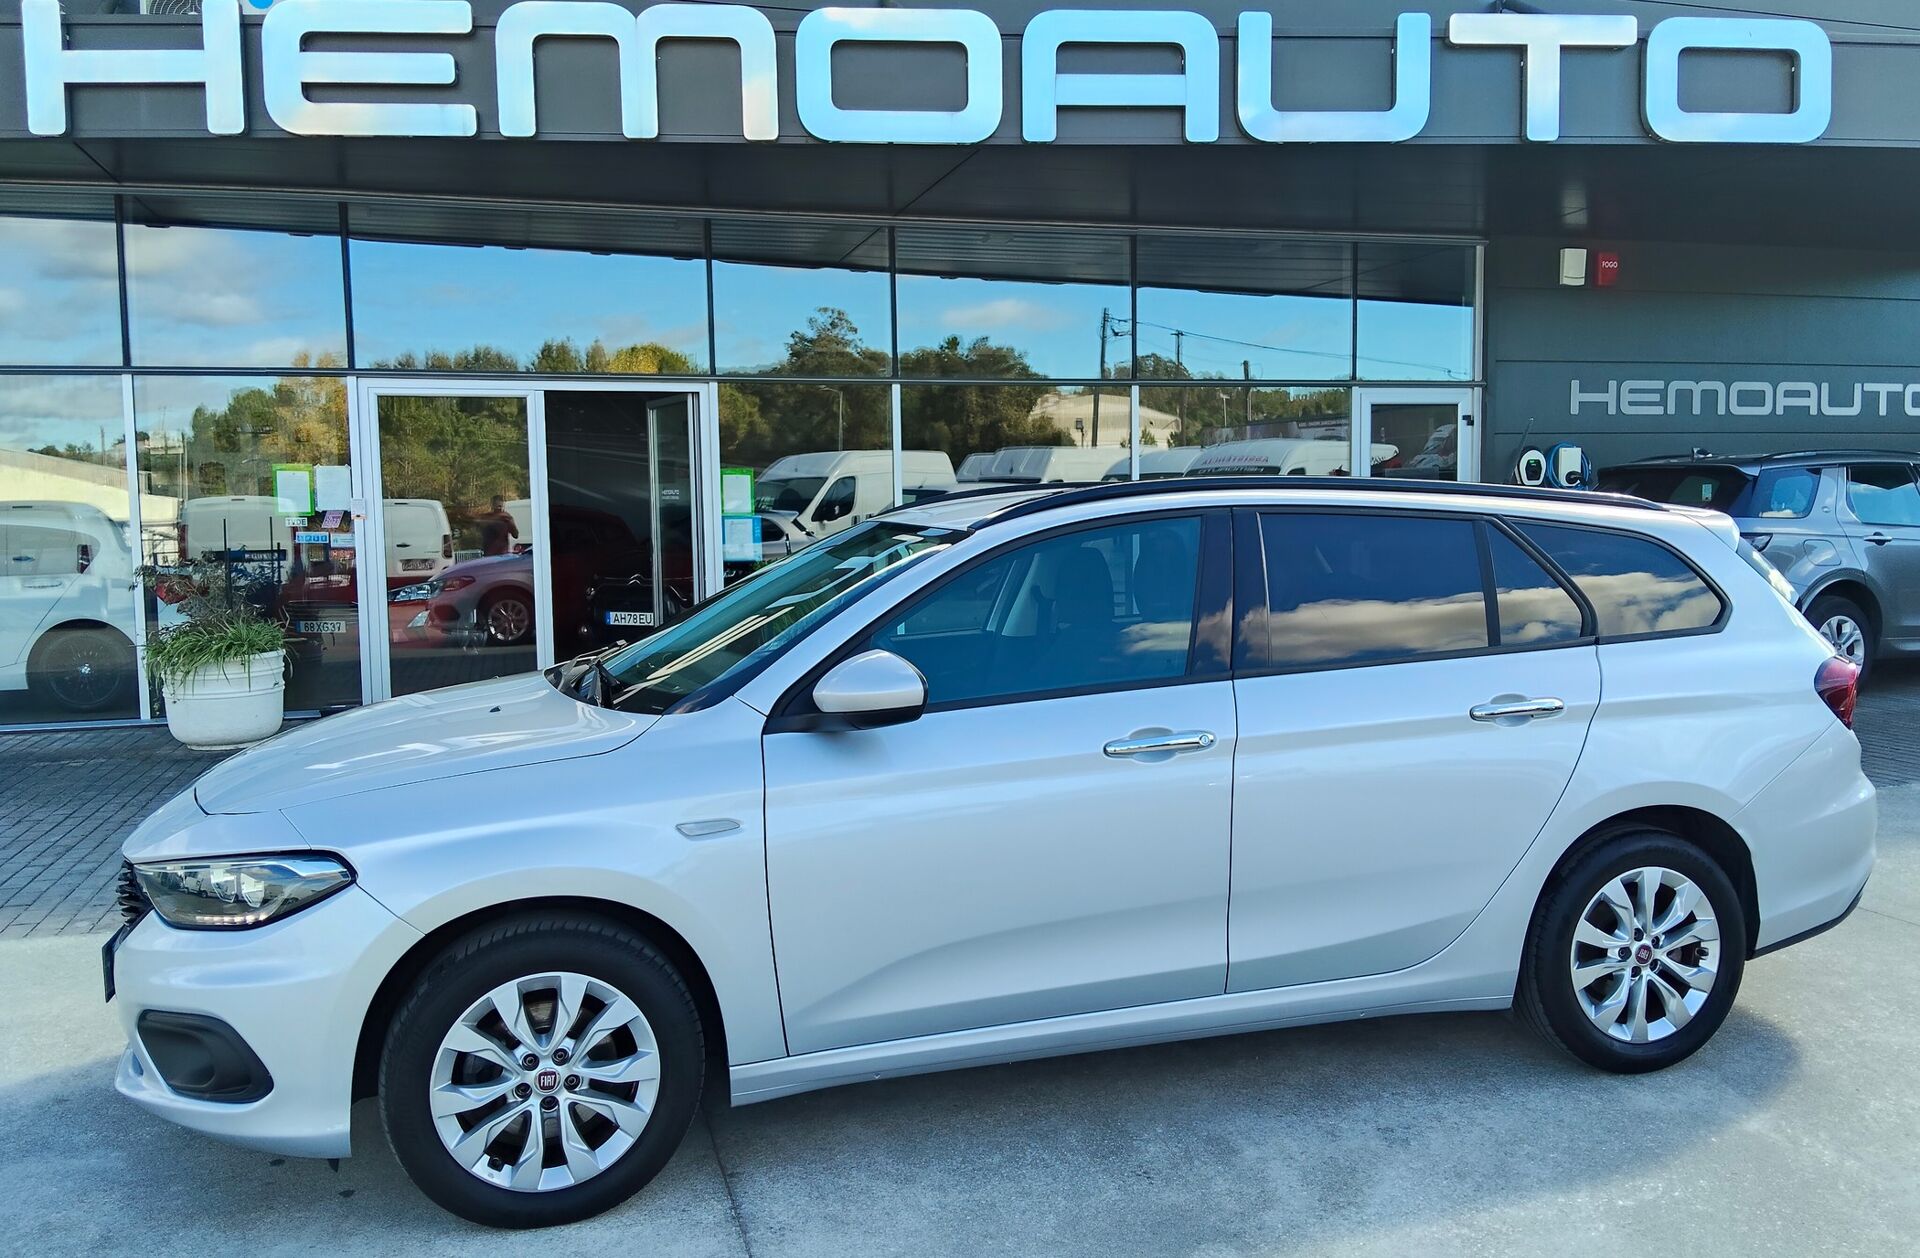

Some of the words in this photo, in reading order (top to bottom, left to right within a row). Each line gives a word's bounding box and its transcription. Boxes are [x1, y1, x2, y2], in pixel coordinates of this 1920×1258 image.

[22, 0, 1833, 144] HEMOAUTO
[1602, 260, 1618, 269] FOGO
[613, 613, 653, 625] AH78EU
[304, 621, 342, 632] 68XG37
[540, 1075, 556, 1087] FIAT
